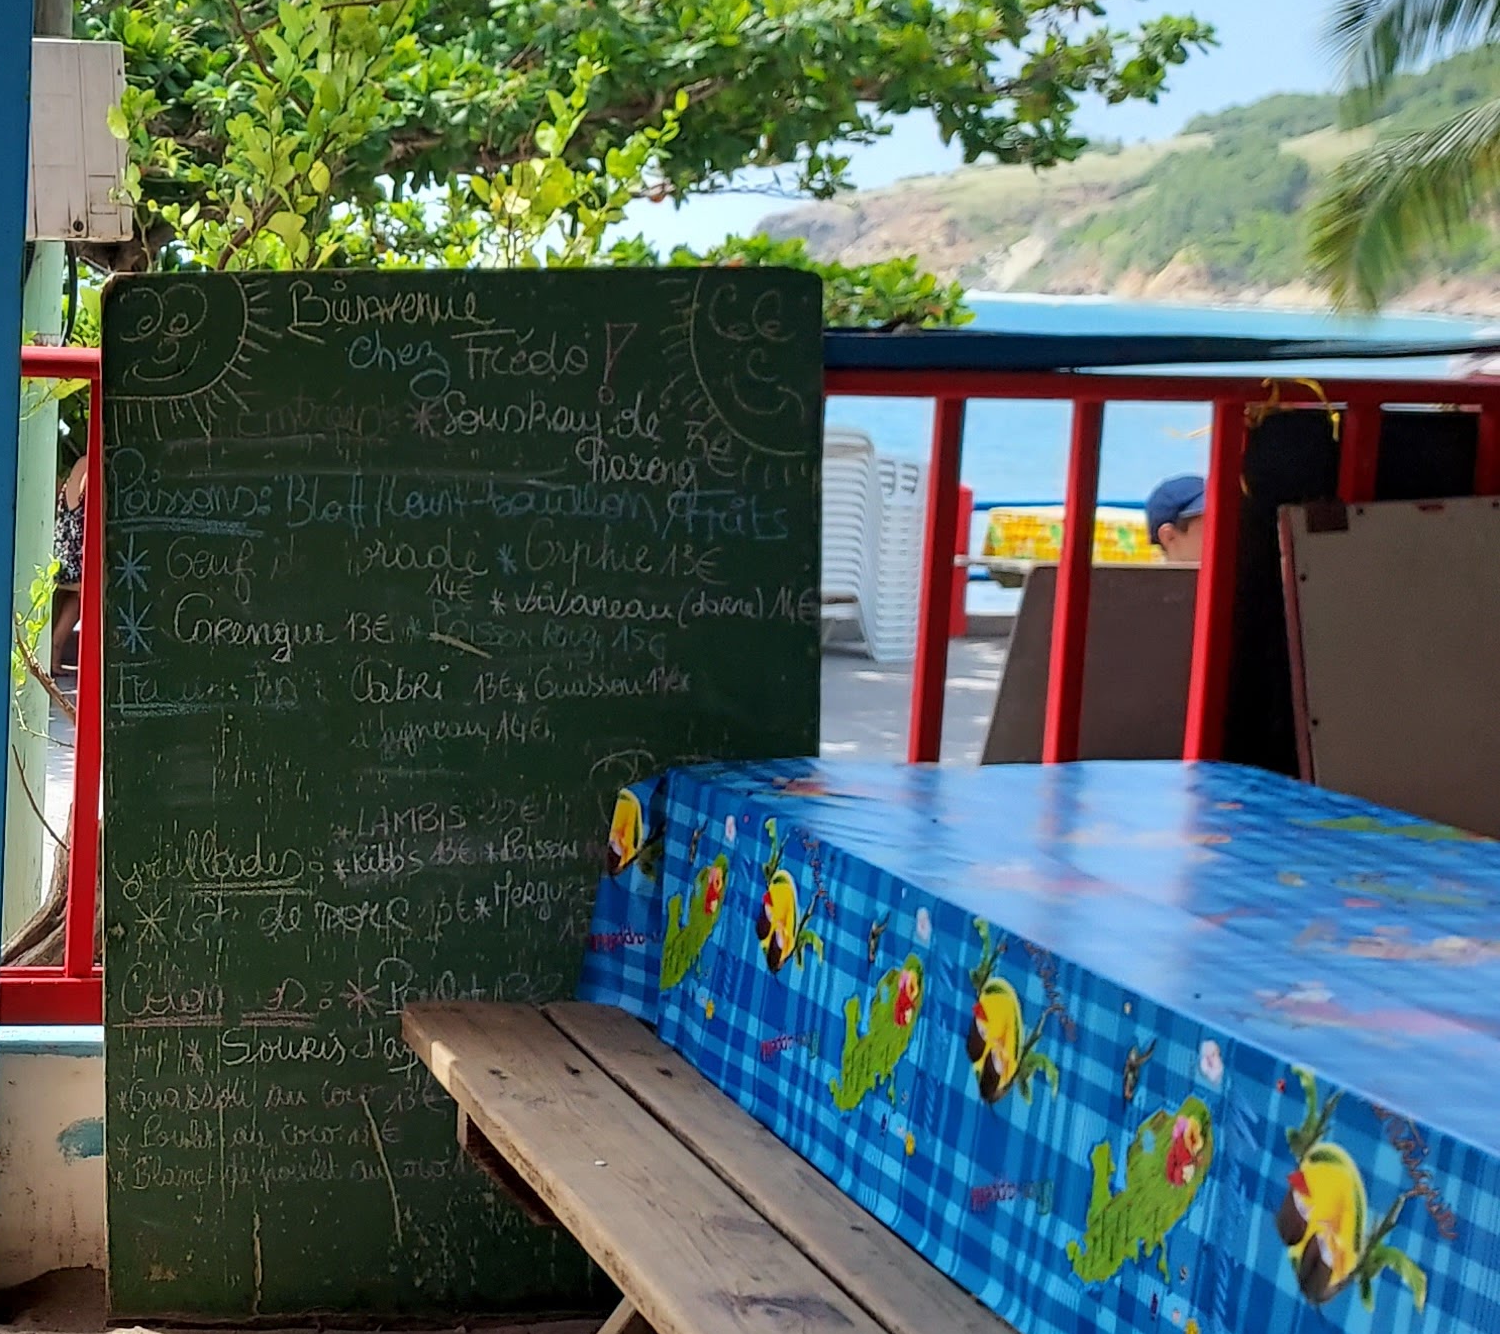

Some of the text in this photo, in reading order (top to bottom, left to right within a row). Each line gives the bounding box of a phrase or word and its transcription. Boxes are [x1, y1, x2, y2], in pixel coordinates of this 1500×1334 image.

[287, 279, 497, 343] Bienvenue
[347, 329, 451, 402] chez
[451, 327, 590, 381] Frédo
[354, 801, 468, 840] LAMBIS
